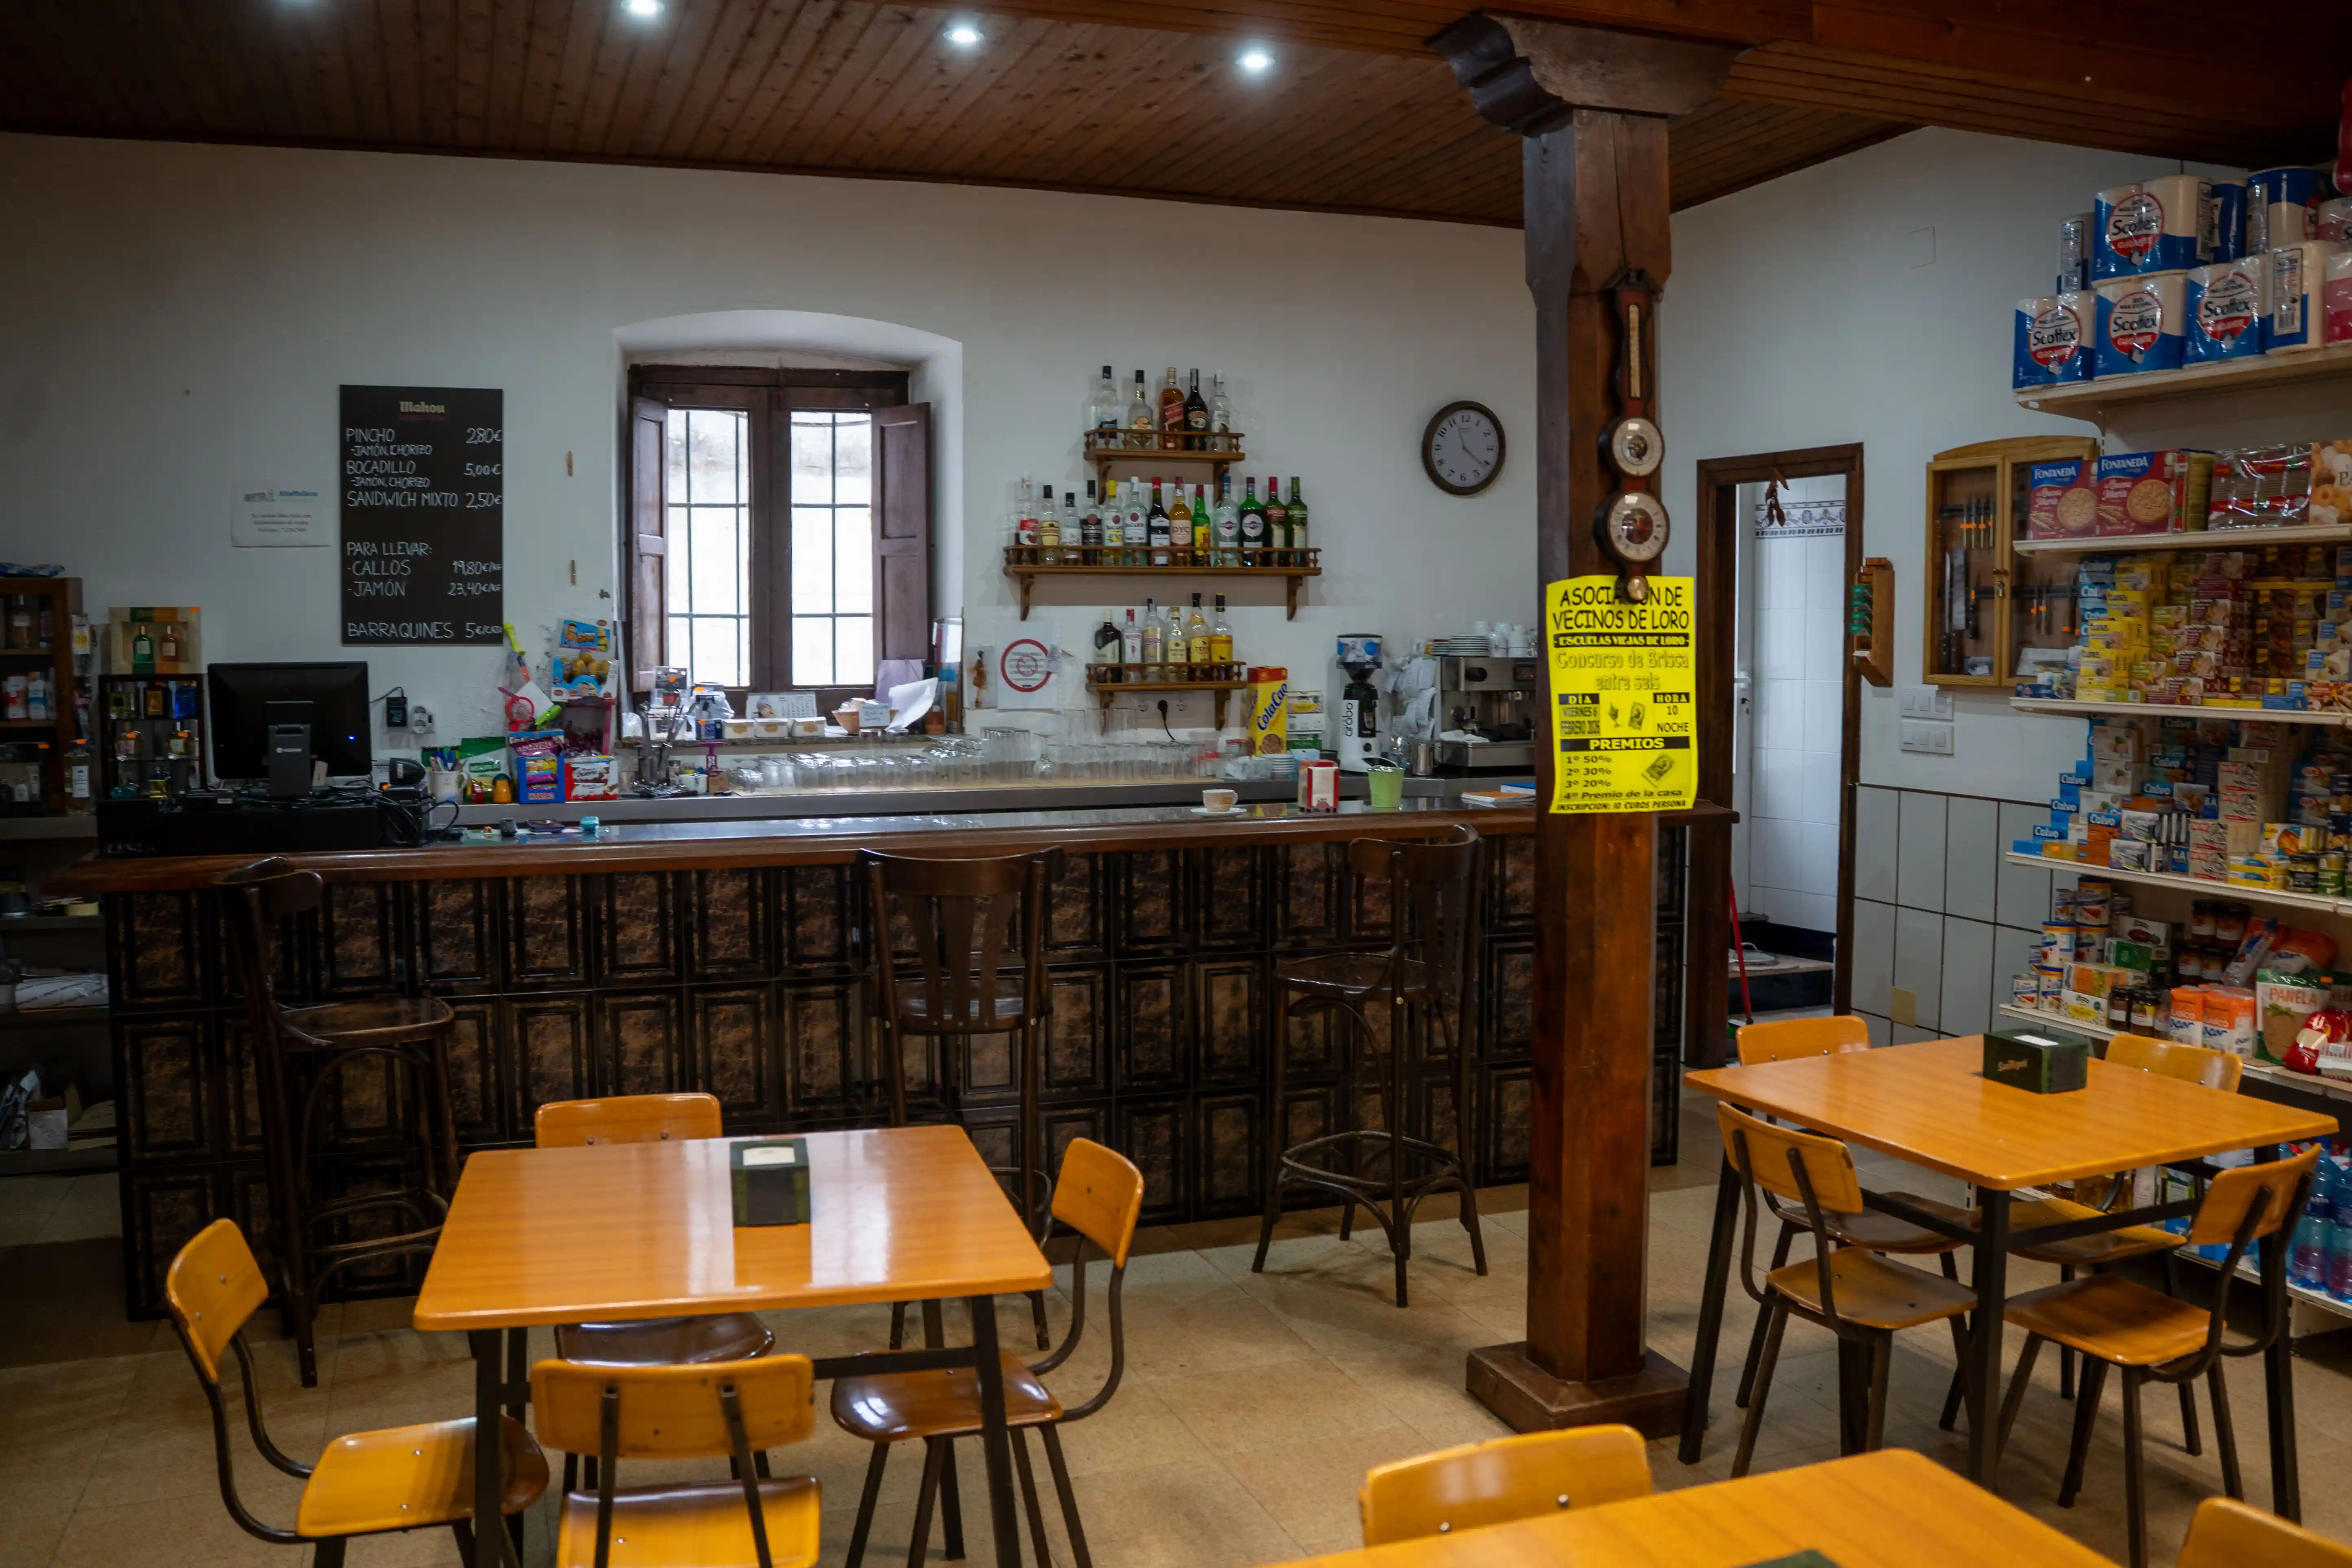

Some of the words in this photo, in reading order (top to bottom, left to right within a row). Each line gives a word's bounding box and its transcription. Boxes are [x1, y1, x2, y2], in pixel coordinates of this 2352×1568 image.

[2033, 328, 2078, 346] Scottex
[399, 400, 446, 413] Mahou
[1449, 418, 1457, 427] 11
[1461, 415, 1471, 423] 12
[346, 426, 395, 443] PINCHO
[1438, 428, 1448, 438] 10
[346, 459, 416, 474] BOCADILLO
[2101, 456, 2148, 471] FONTANEDA
[1460, 473, 1467, 482] 6
[2034, 466, 2077, 480] FONTANEDA
[346, 490, 417, 507] SANDWICH
[421, 491, 459, 508] MIXTO
[347, 541, 378, 557] PARA
[1560, 586, 1660, 607] ASOCIN
[1665, 586, 1682, 606] DE
[1553, 610, 1624, 630] VECINOS
[1629, 610, 1647, 630] DE
[1651, 610, 1689, 630] LORO
[347, 621, 455, 639] BARRAQUINES
[1646, 636, 1659, 645] DE
[1555, 650, 1624, 669] Concurso
[1628, 649, 1644, 668] de
[1647, 649, 1689, 669] Brisca
[1595, 672, 1631, 691] entre
[1634, 672, 1660, 691] seis
[1656, 694, 1687, 703] HORA
[1257, 683, 1288, 731] ColaCao
[1667, 705, 1678, 715] 10
[1657, 722, 1689, 733] NOCHE
[1589, 738, 1665, 750] PREMIOS
[1566, 755, 1580, 764] 1º
[1583, 755, 1612, 764] 50%
[1566, 768, 1580, 776] 2º
[1583, 767, 1612, 775] 30%
[1566, 780, 1579, 788] 3º
[1583, 779, 1611, 787] 20%
[1581, 791, 1623, 799] Premio
[1626, 790, 1640, 798] de
[1652, 800, 1686, 809] PERSONA
[2269, 987, 2317, 1006] PANELA
